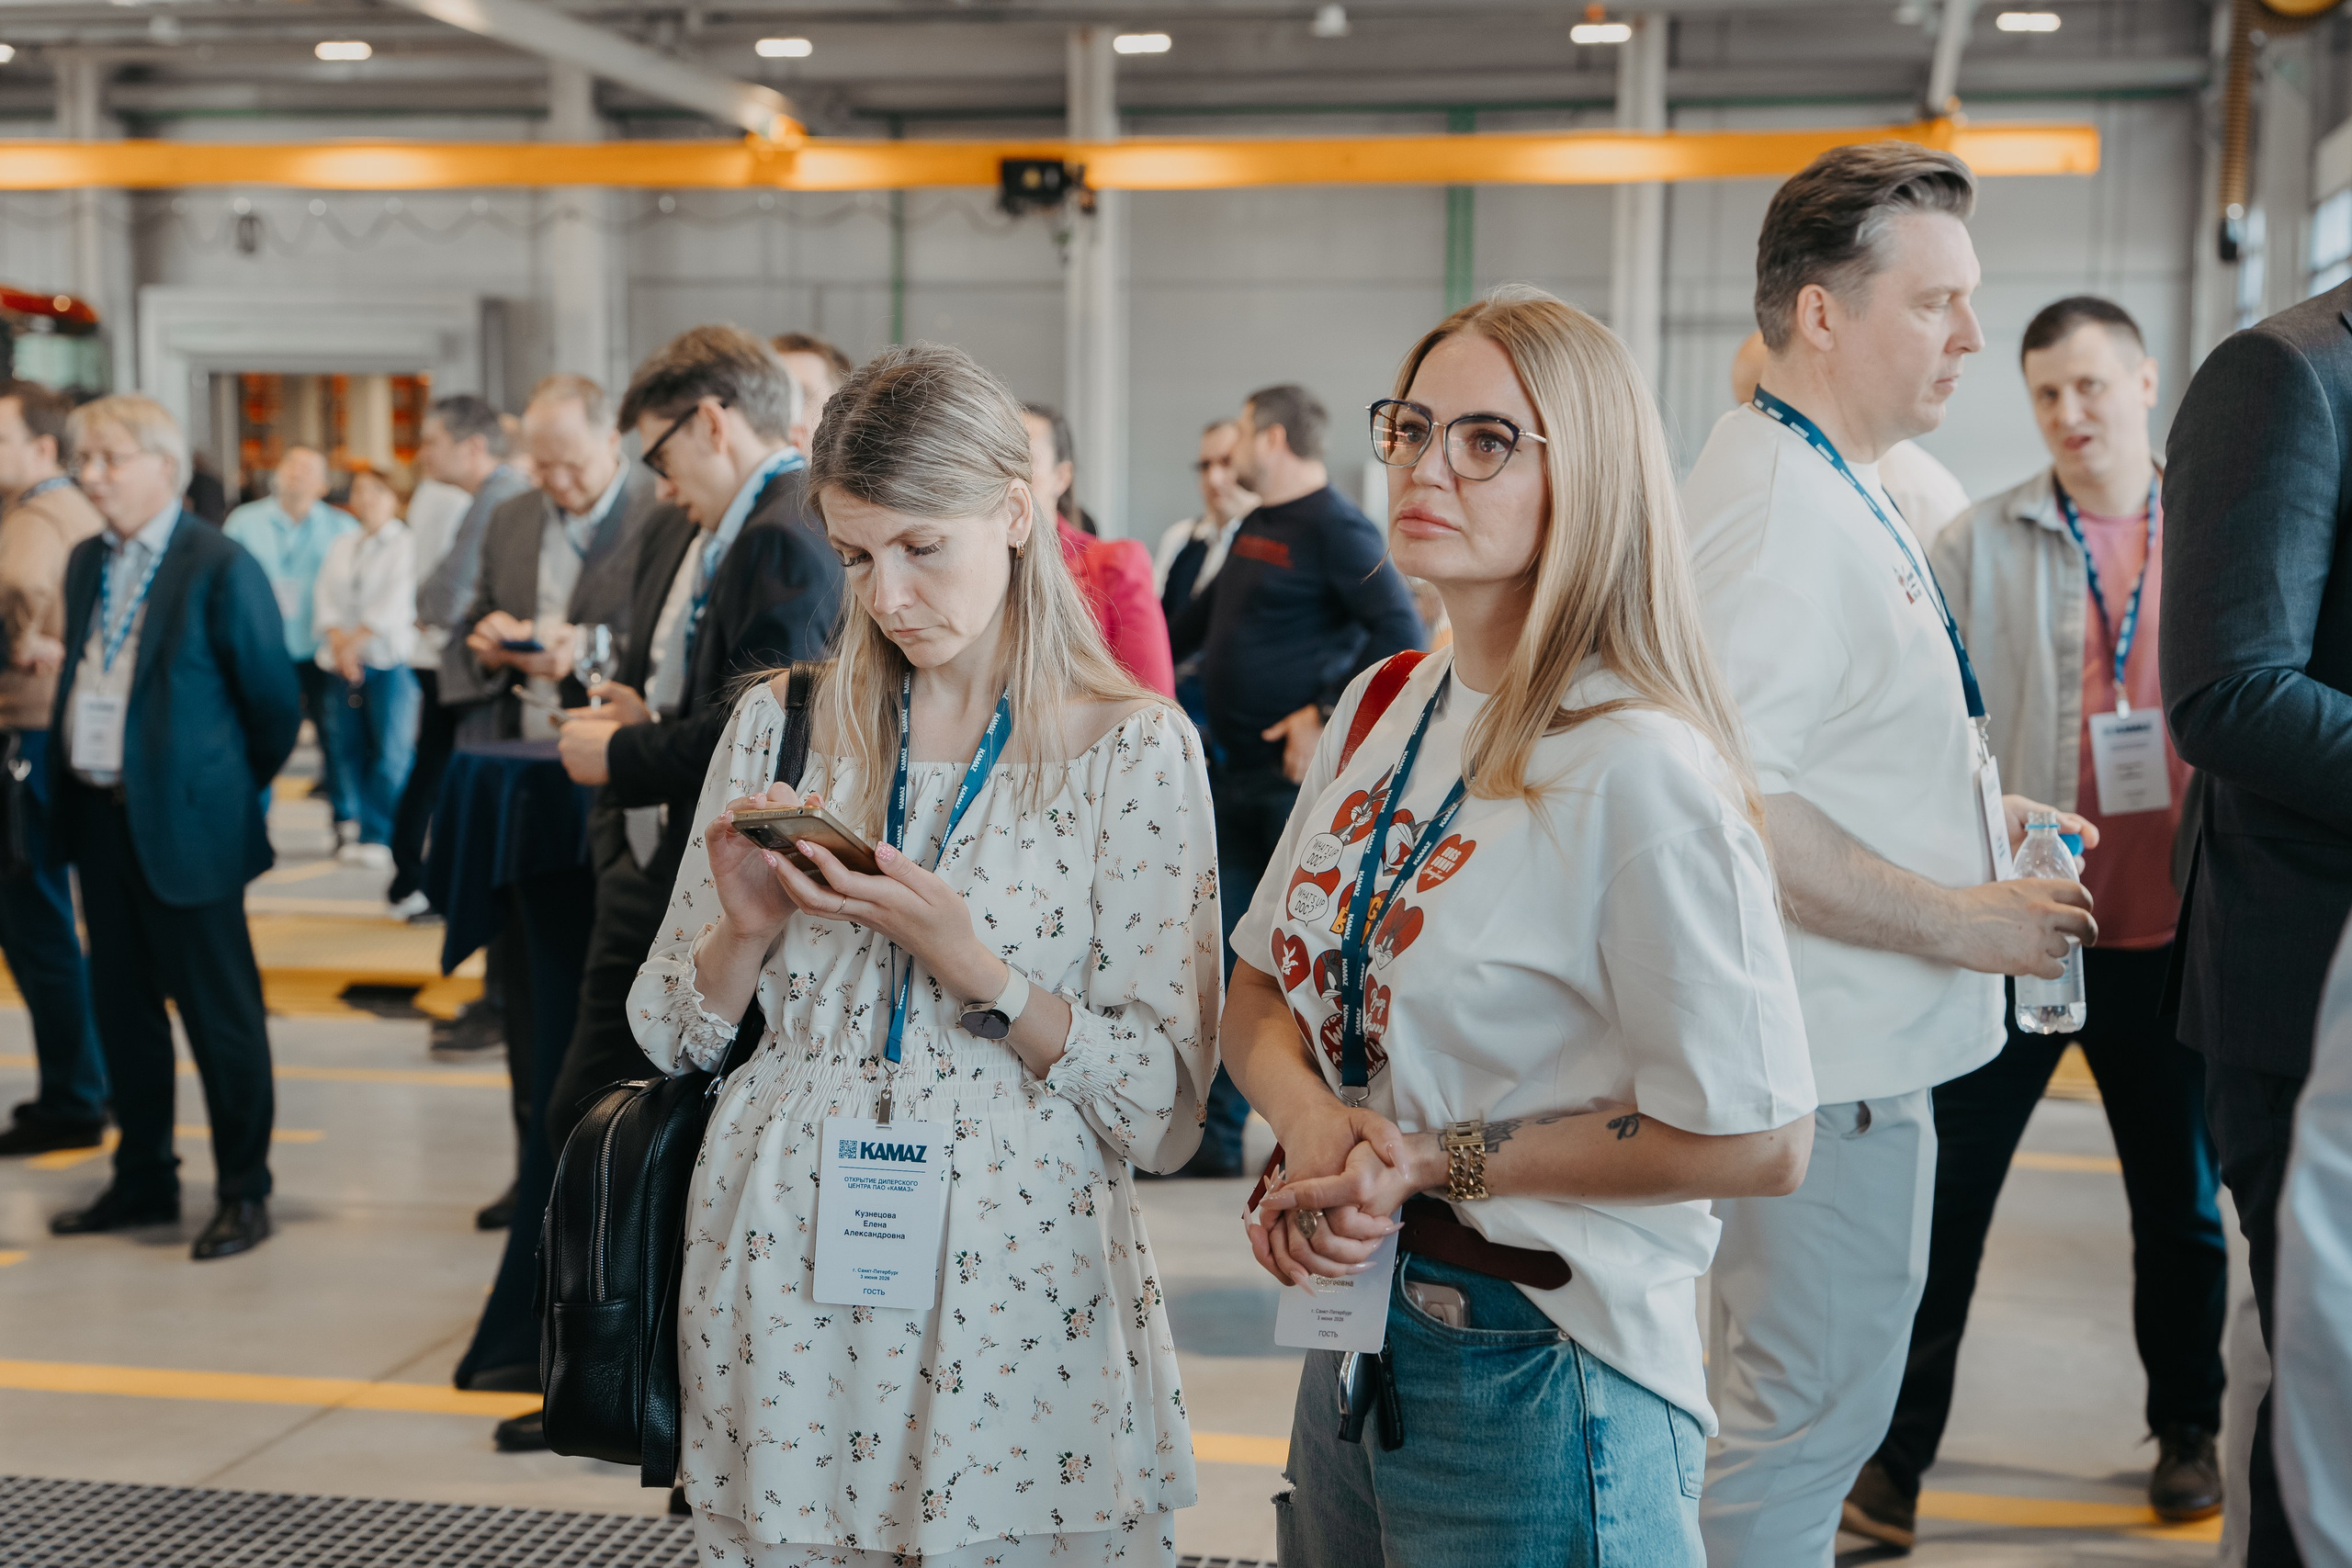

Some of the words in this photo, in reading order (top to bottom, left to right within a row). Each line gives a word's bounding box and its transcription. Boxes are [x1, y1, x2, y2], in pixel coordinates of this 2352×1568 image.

[969, 748, 986, 773] KAMAZ
[955, 784, 968, 809] KAMAZ
[1364, 829, 1377, 854] KAMAZ
[1413, 840, 1432, 865] KAMAZ
[1353, 870, 1365, 897] KAMAZ
[1343, 913, 1354, 941] KAMAZ
[860, 1142, 927, 1163] KAMAZ
[843, 1176, 876, 1184] ОТКРЫТИЕ
[877, 1179, 919, 1187] ДИЛЕРСКОГО
[854, 1209, 897, 1219] Кузнецова
[863, 1220, 888, 1228] Елена
[843, 1228, 906, 1239] Александровна
[857, 1267, 899, 1276] Санкт-Петербург
[863, 1288, 886, 1296] ГОСТЬ
